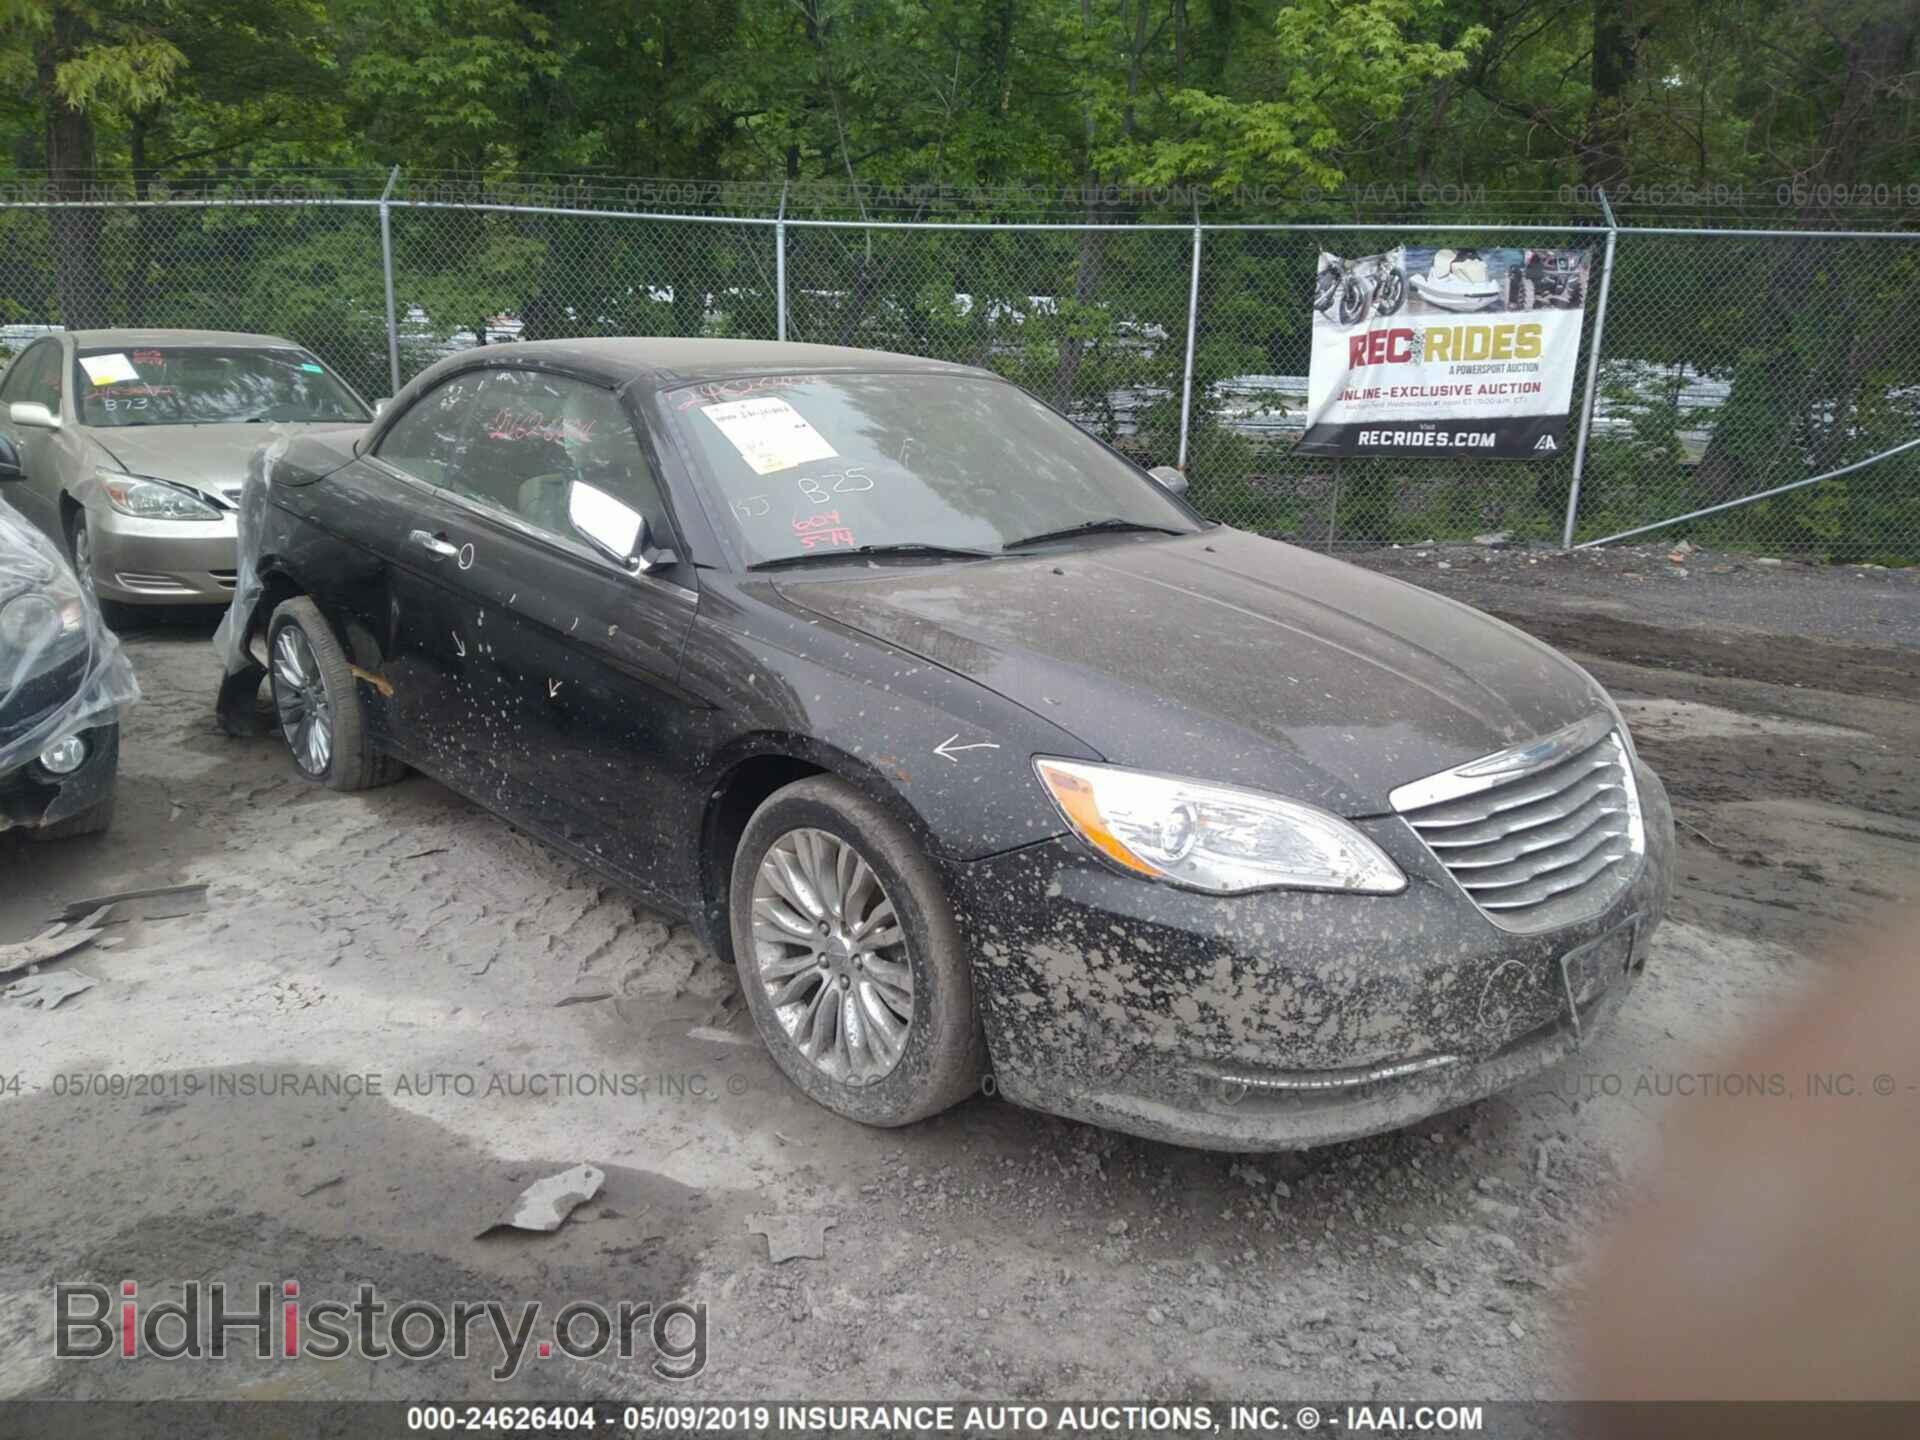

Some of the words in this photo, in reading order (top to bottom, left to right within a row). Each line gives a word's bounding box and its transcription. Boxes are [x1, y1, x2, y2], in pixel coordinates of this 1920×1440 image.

[1349, 328, 1414, 370] REC
[1423, 323, 1543, 363] RIDES
[1449, 366, 1455, 375] A
[1456, 363, 1506, 375] POWERSPORT
[1507, 362, 1539, 374] AUCTION
[1477, 382, 1542, 396] AUCTION
[1358, 431, 1497, 447] RECRIDES.COM
[798, 467, 875, 504] B25
